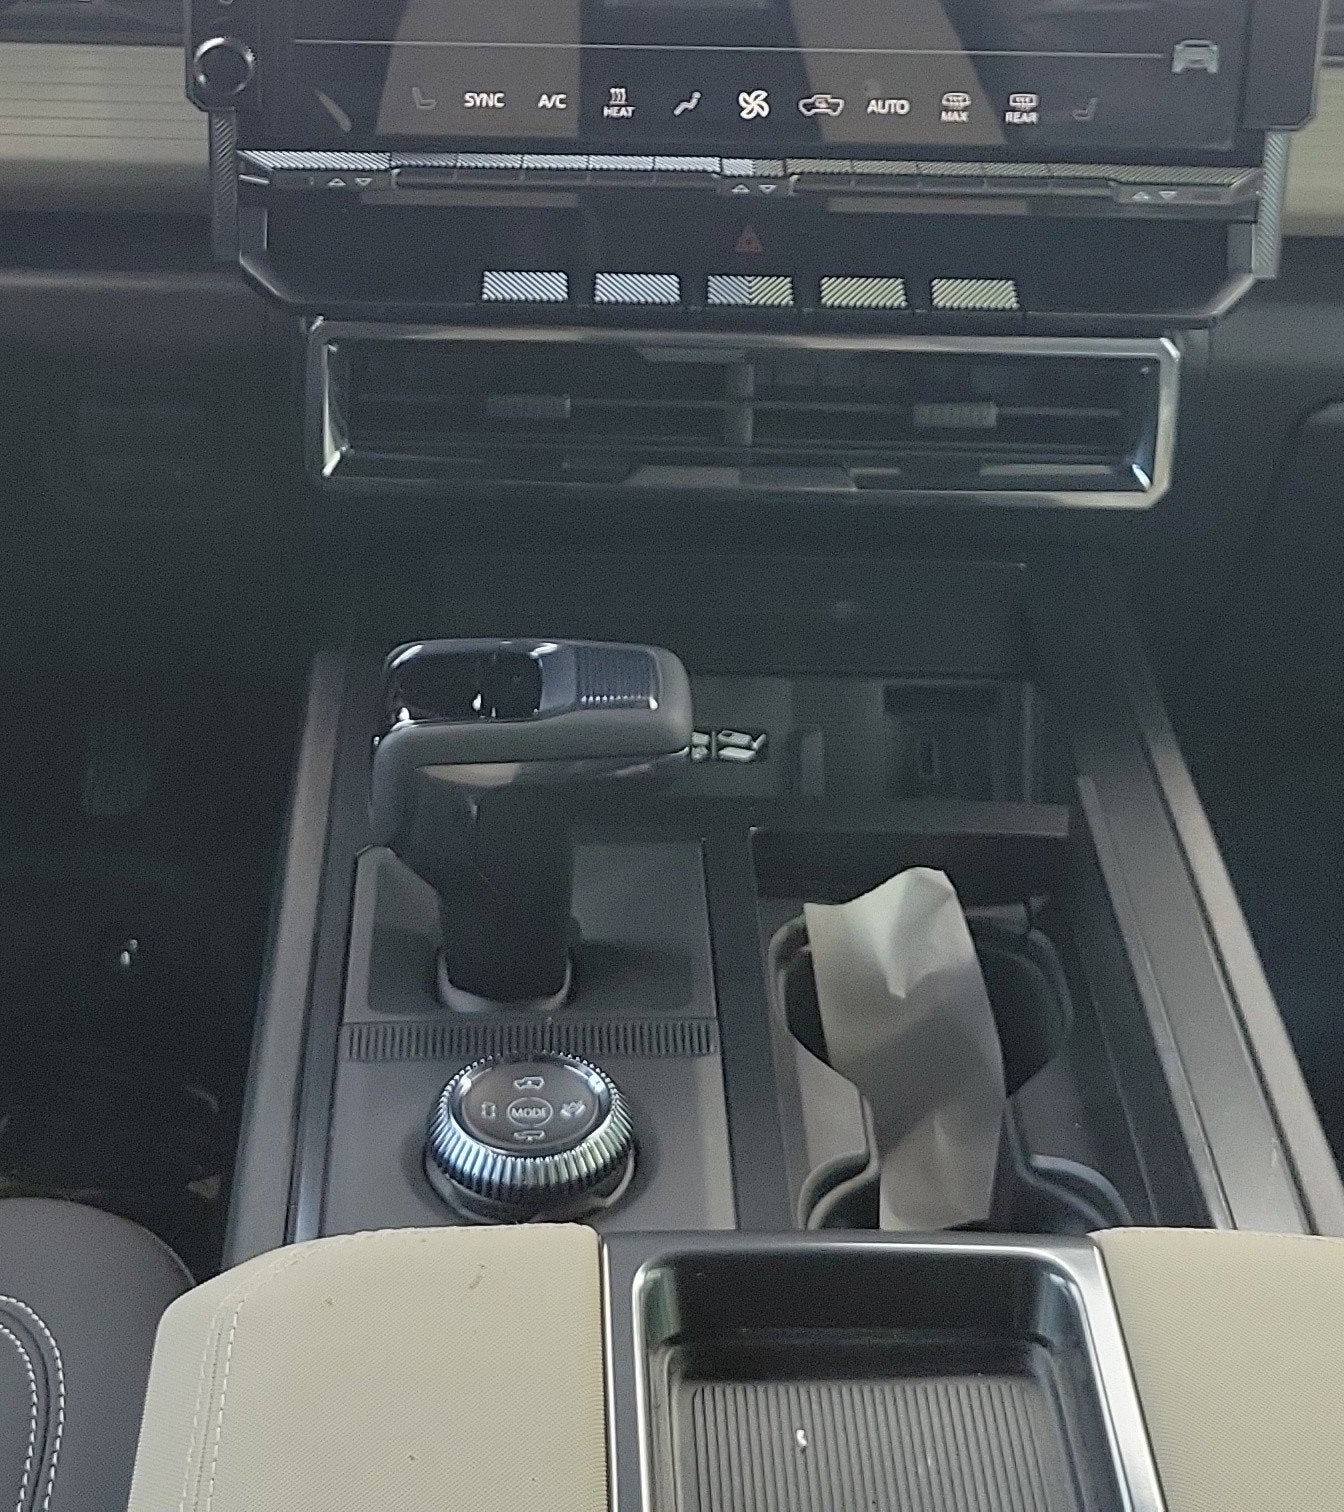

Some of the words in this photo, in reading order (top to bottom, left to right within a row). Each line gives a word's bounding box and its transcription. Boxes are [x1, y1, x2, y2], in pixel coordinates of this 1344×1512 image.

[463, 92, 505, 108] SYNC
[537, 93, 567, 108] A/C
[603, 106, 636, 118] HEAT
[866, 99, 911, 115] AUTO
[940, 110, 969, 122] MAX
[1005, 111, 1039, 124] REAR
[511, 1106, 548, 1118] MODE
